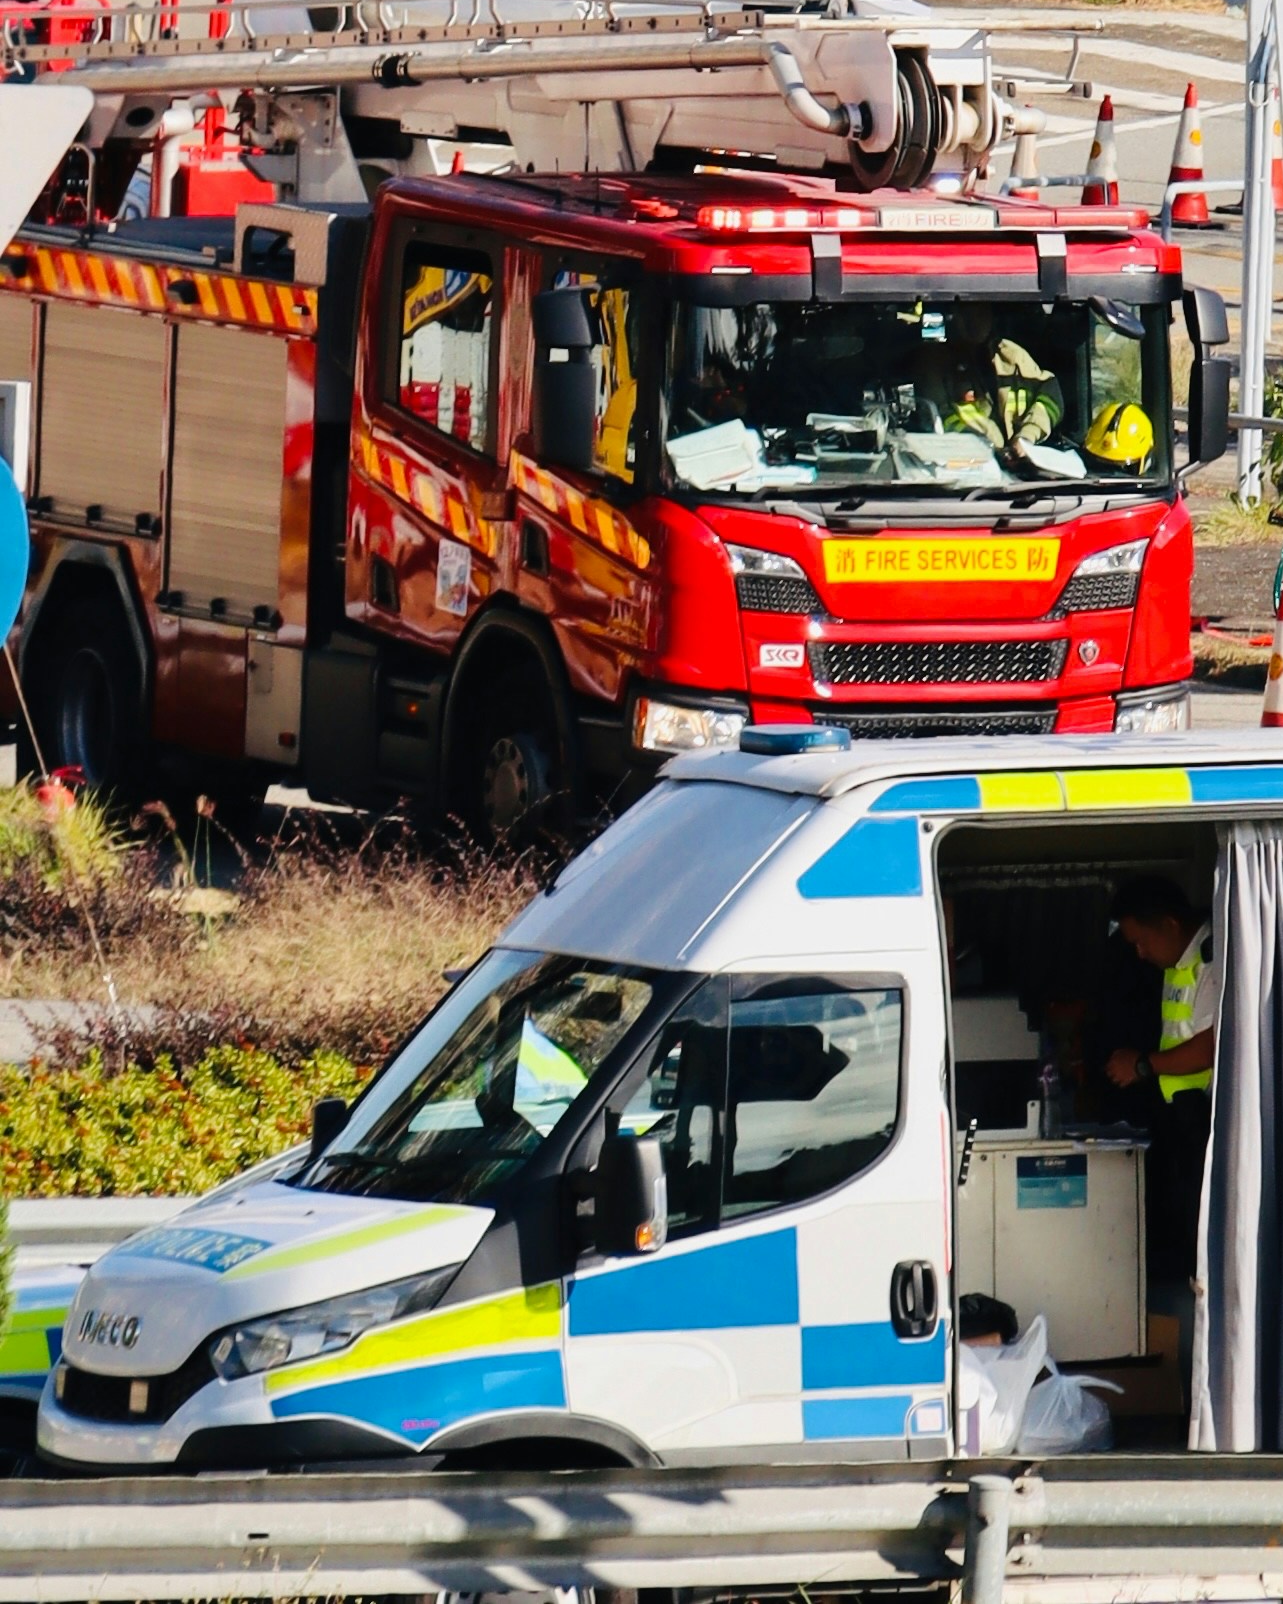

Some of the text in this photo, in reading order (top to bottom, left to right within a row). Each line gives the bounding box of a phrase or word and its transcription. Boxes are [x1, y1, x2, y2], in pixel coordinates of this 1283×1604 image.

[914, 213, 961, 227] FIRE
[836, 546, 1049, 573] 消 FIRE SERVICES 防
